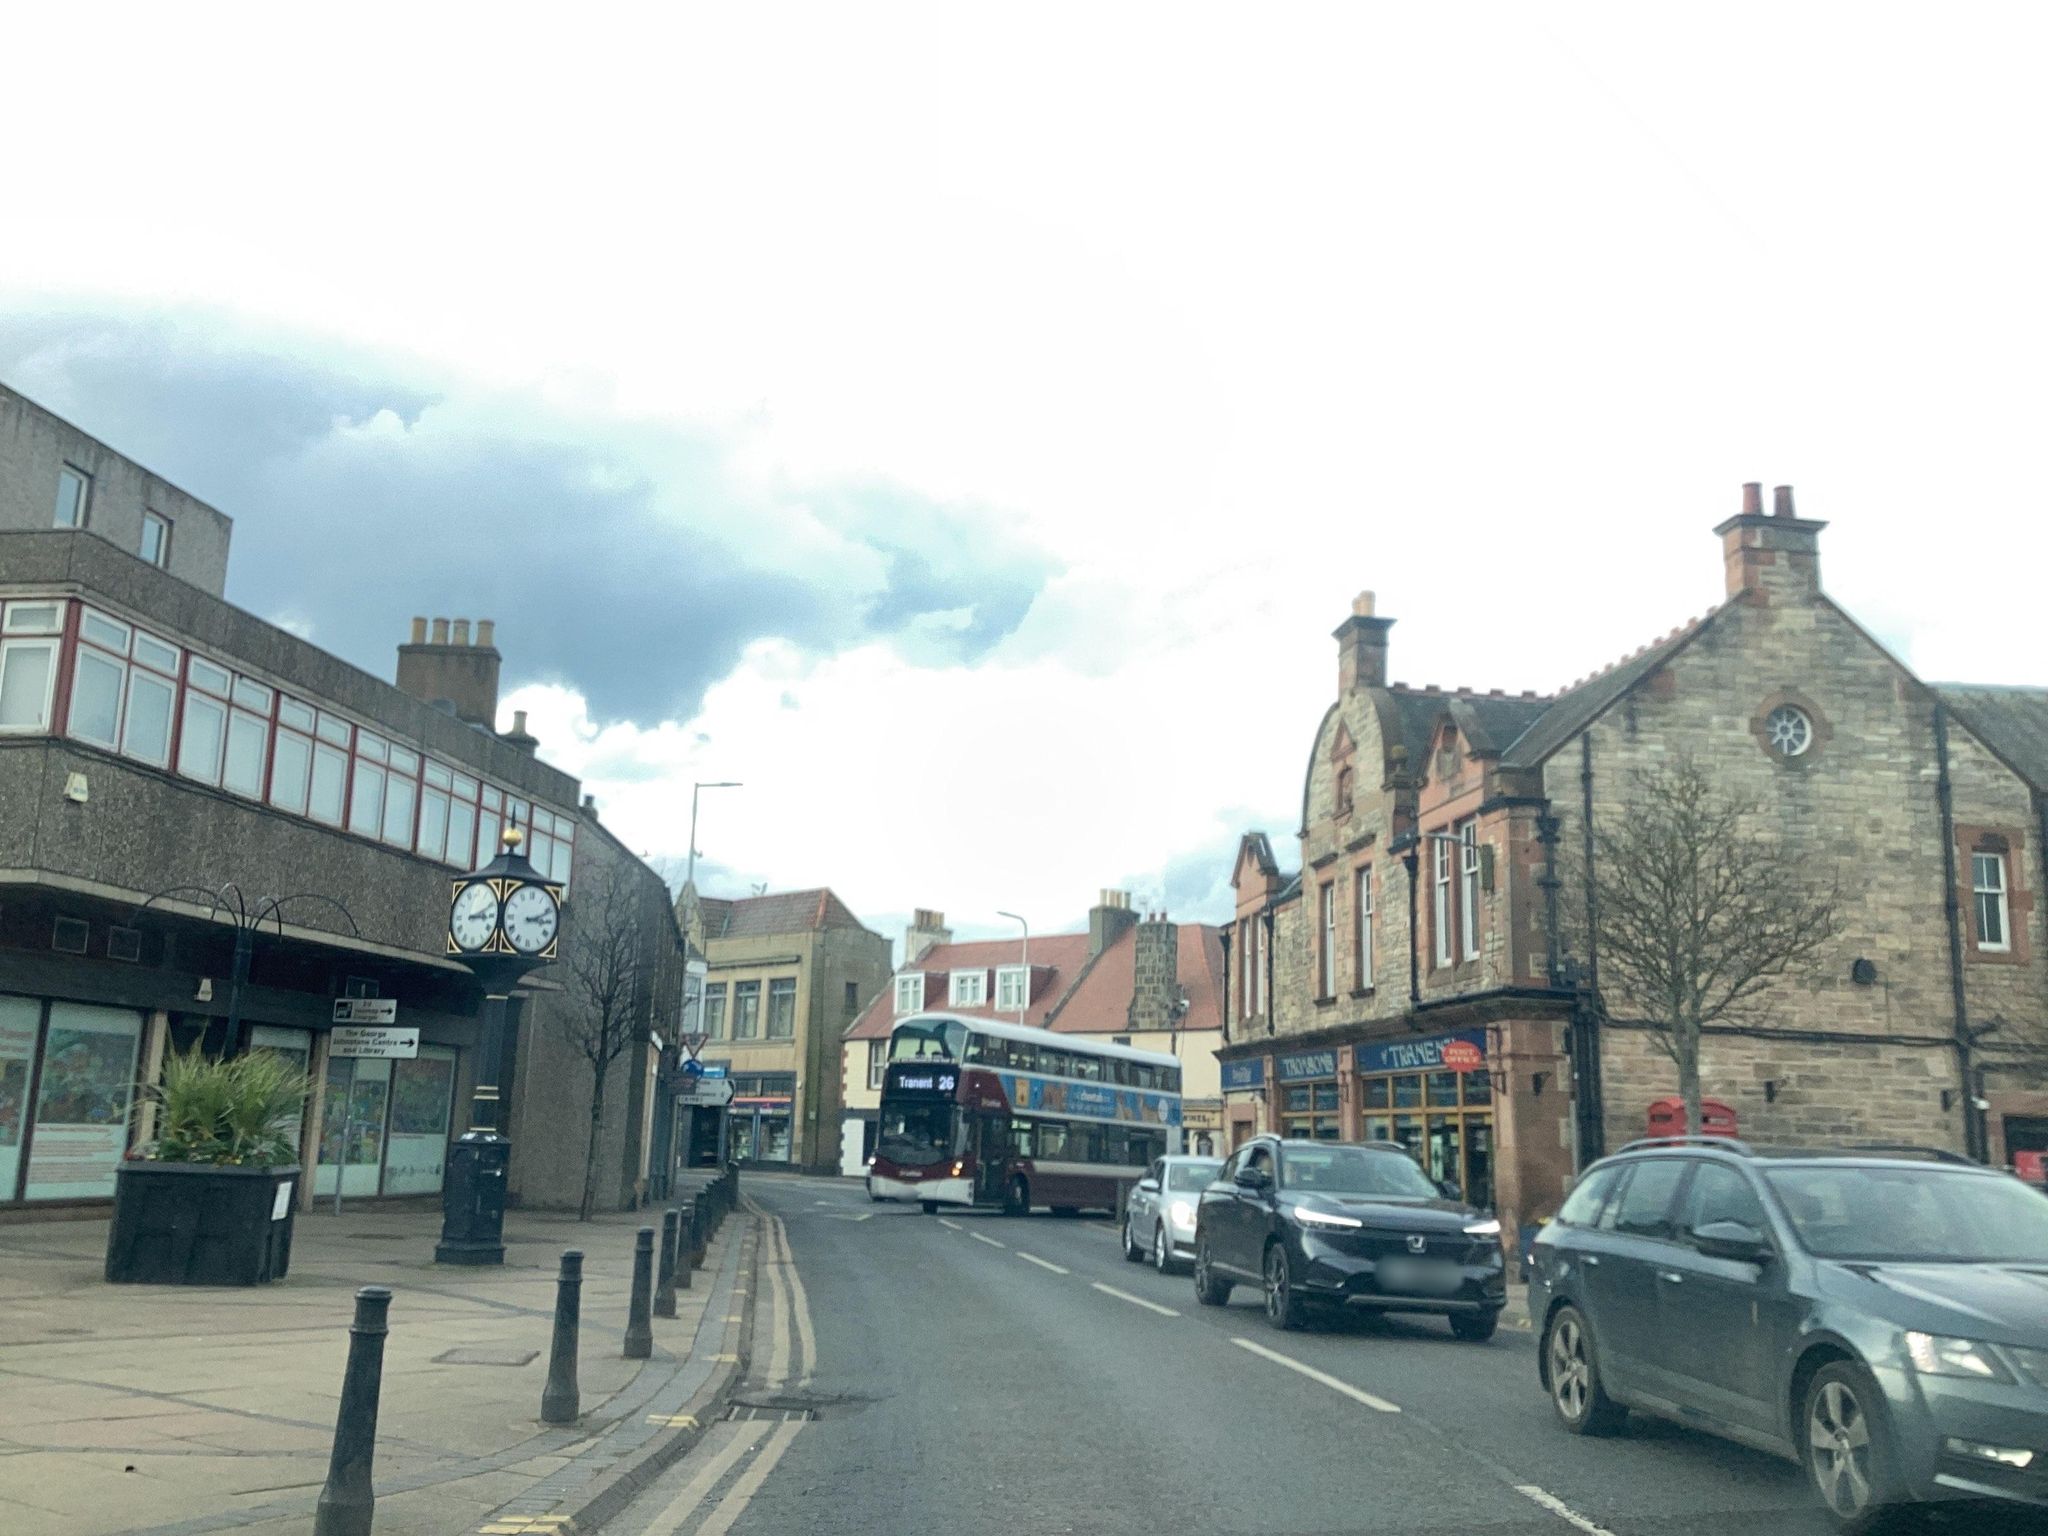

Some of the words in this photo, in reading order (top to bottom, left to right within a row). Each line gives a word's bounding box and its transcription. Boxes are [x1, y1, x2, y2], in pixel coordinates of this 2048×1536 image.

[360, 1029, 387, 1038] George
[359, 1047, 386, 1055] Library
[1449, 1048, 1474, 1056] POST
[899, 1076, 933, 1089] Tranent
[938, 1075, 955, 1090] 26
